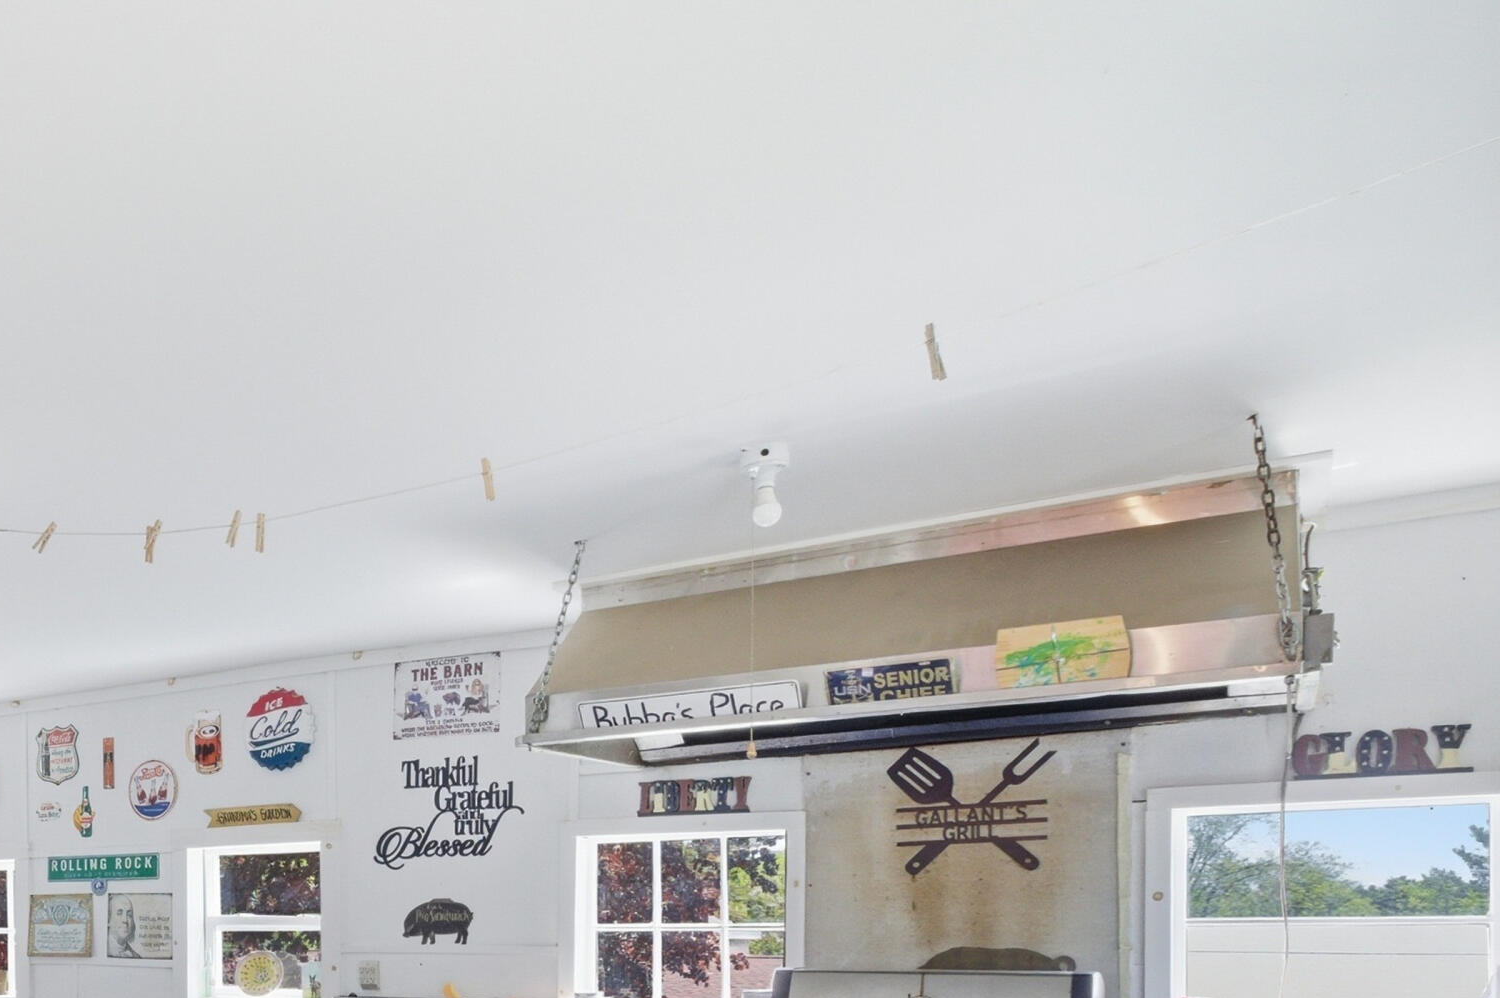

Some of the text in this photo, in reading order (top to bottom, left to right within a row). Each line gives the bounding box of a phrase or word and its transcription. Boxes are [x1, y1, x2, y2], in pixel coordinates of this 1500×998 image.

[411, 662, 484, 682] THE BARN
[873, 666, 950, 689] SENIOR
[265, 697, 284, 711] ICE
[709, 692, 784, 717] Place
[880, 685, 946, 701] CHIEF
[250, 708, 302, 741] Cold
[260, 743, 296, 759] DRINKS
[401, 755, 478, 789] Thankful
[434, 781, 513, 811] Grateful
[638, 776, 752, 816] LIBERTY
[454, 812, 496, 836] truly
[915, 804, 1028, 825] GALLANT'S
[374, 805, 524, 870] Blessed
[943, 823, 999, 841] GRILL
[51, 856, 153, 872] ROLLING ROCK
